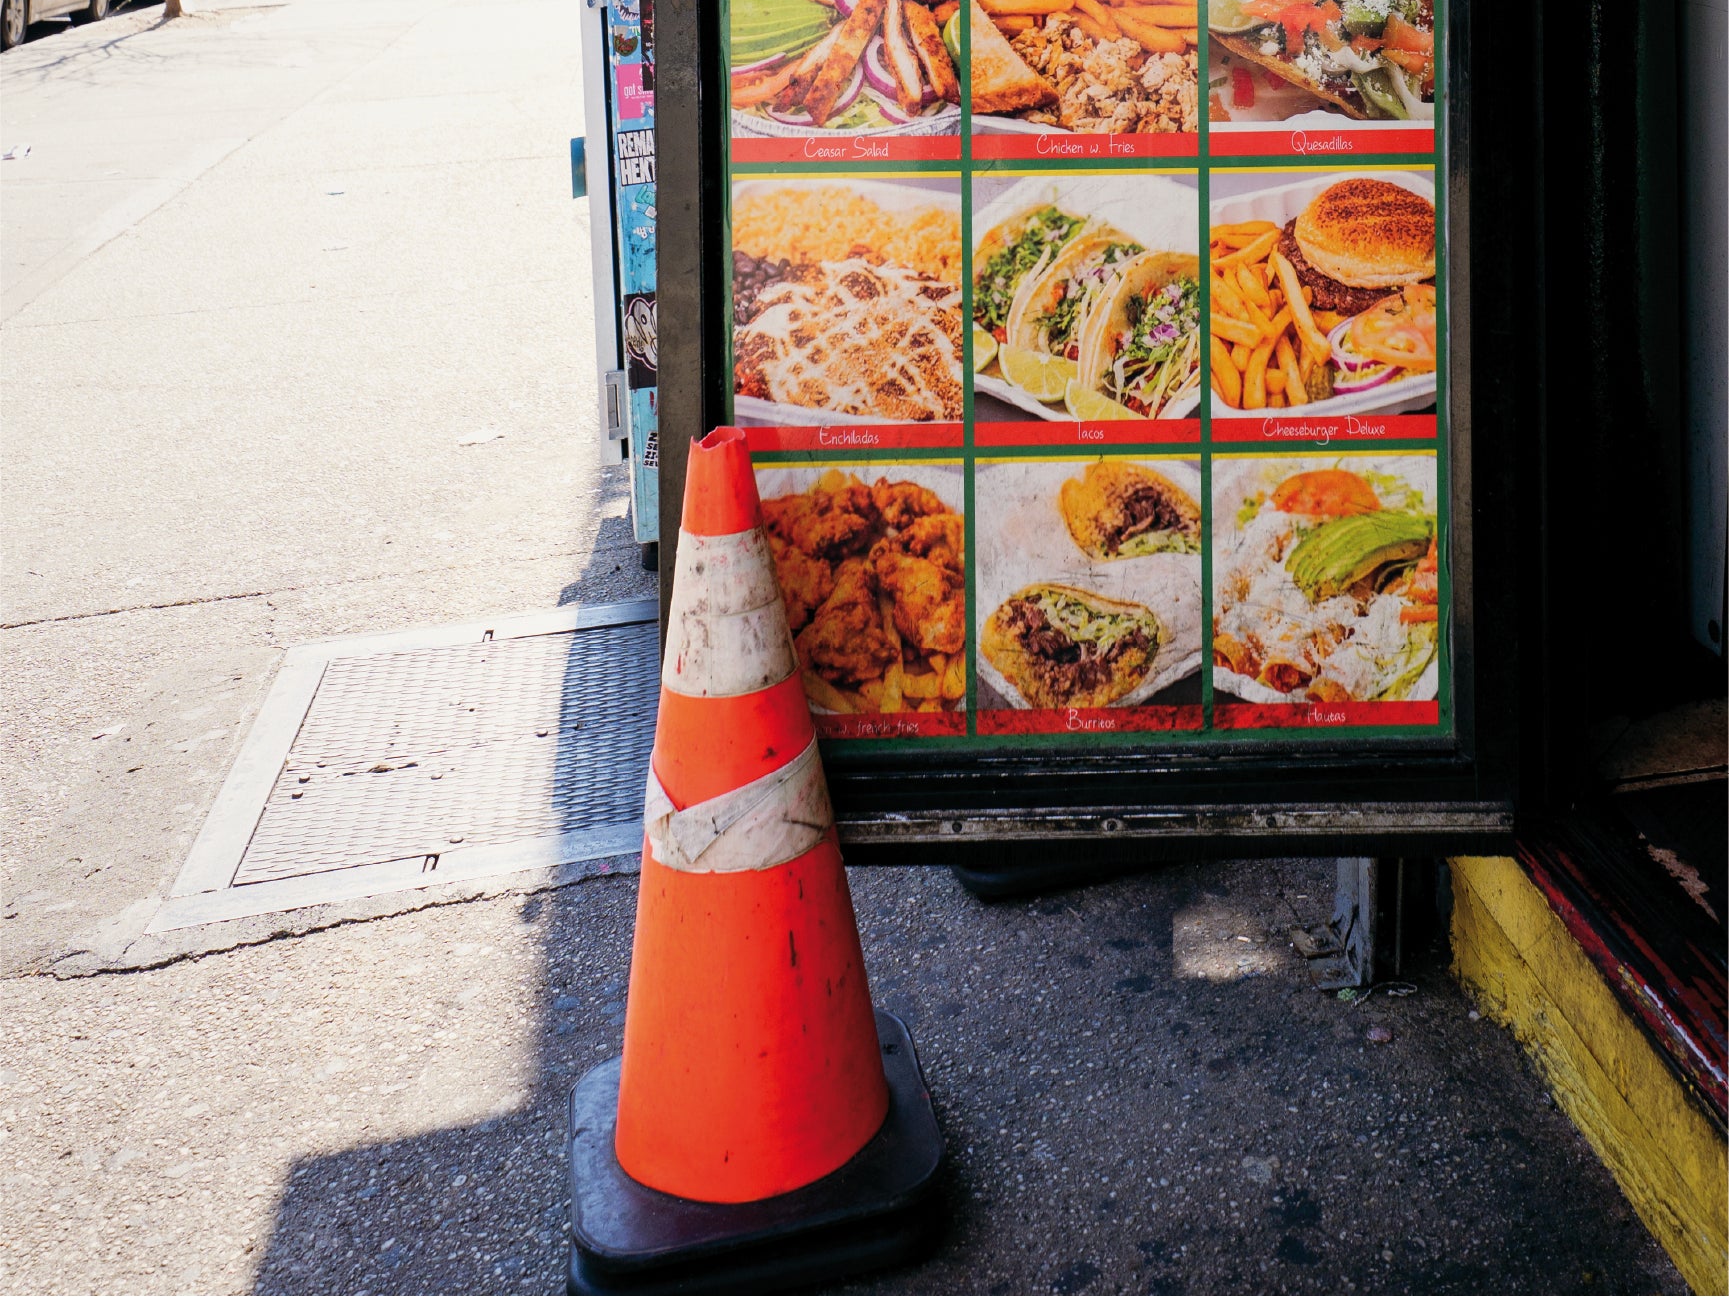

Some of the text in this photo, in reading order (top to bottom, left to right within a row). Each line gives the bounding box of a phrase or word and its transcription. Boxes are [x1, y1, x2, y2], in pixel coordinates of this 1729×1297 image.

[624, 83, 636, 99] got
[803, 137, 889, 159] Ceasar Salad
[1036, 133, 1135, 155] Chicken w. Fries
[1291, 130, 1353, 155] Quesadillas
[819, 425, 880, 445] Enchiladas
[1073, 419, 1105, 441] Tacos
[1262, 415, 1386, 446] Cheeseburger Deluxe
[897, 719, 919, 735] fries
[1065, 707, 1116, 731] Burritos
